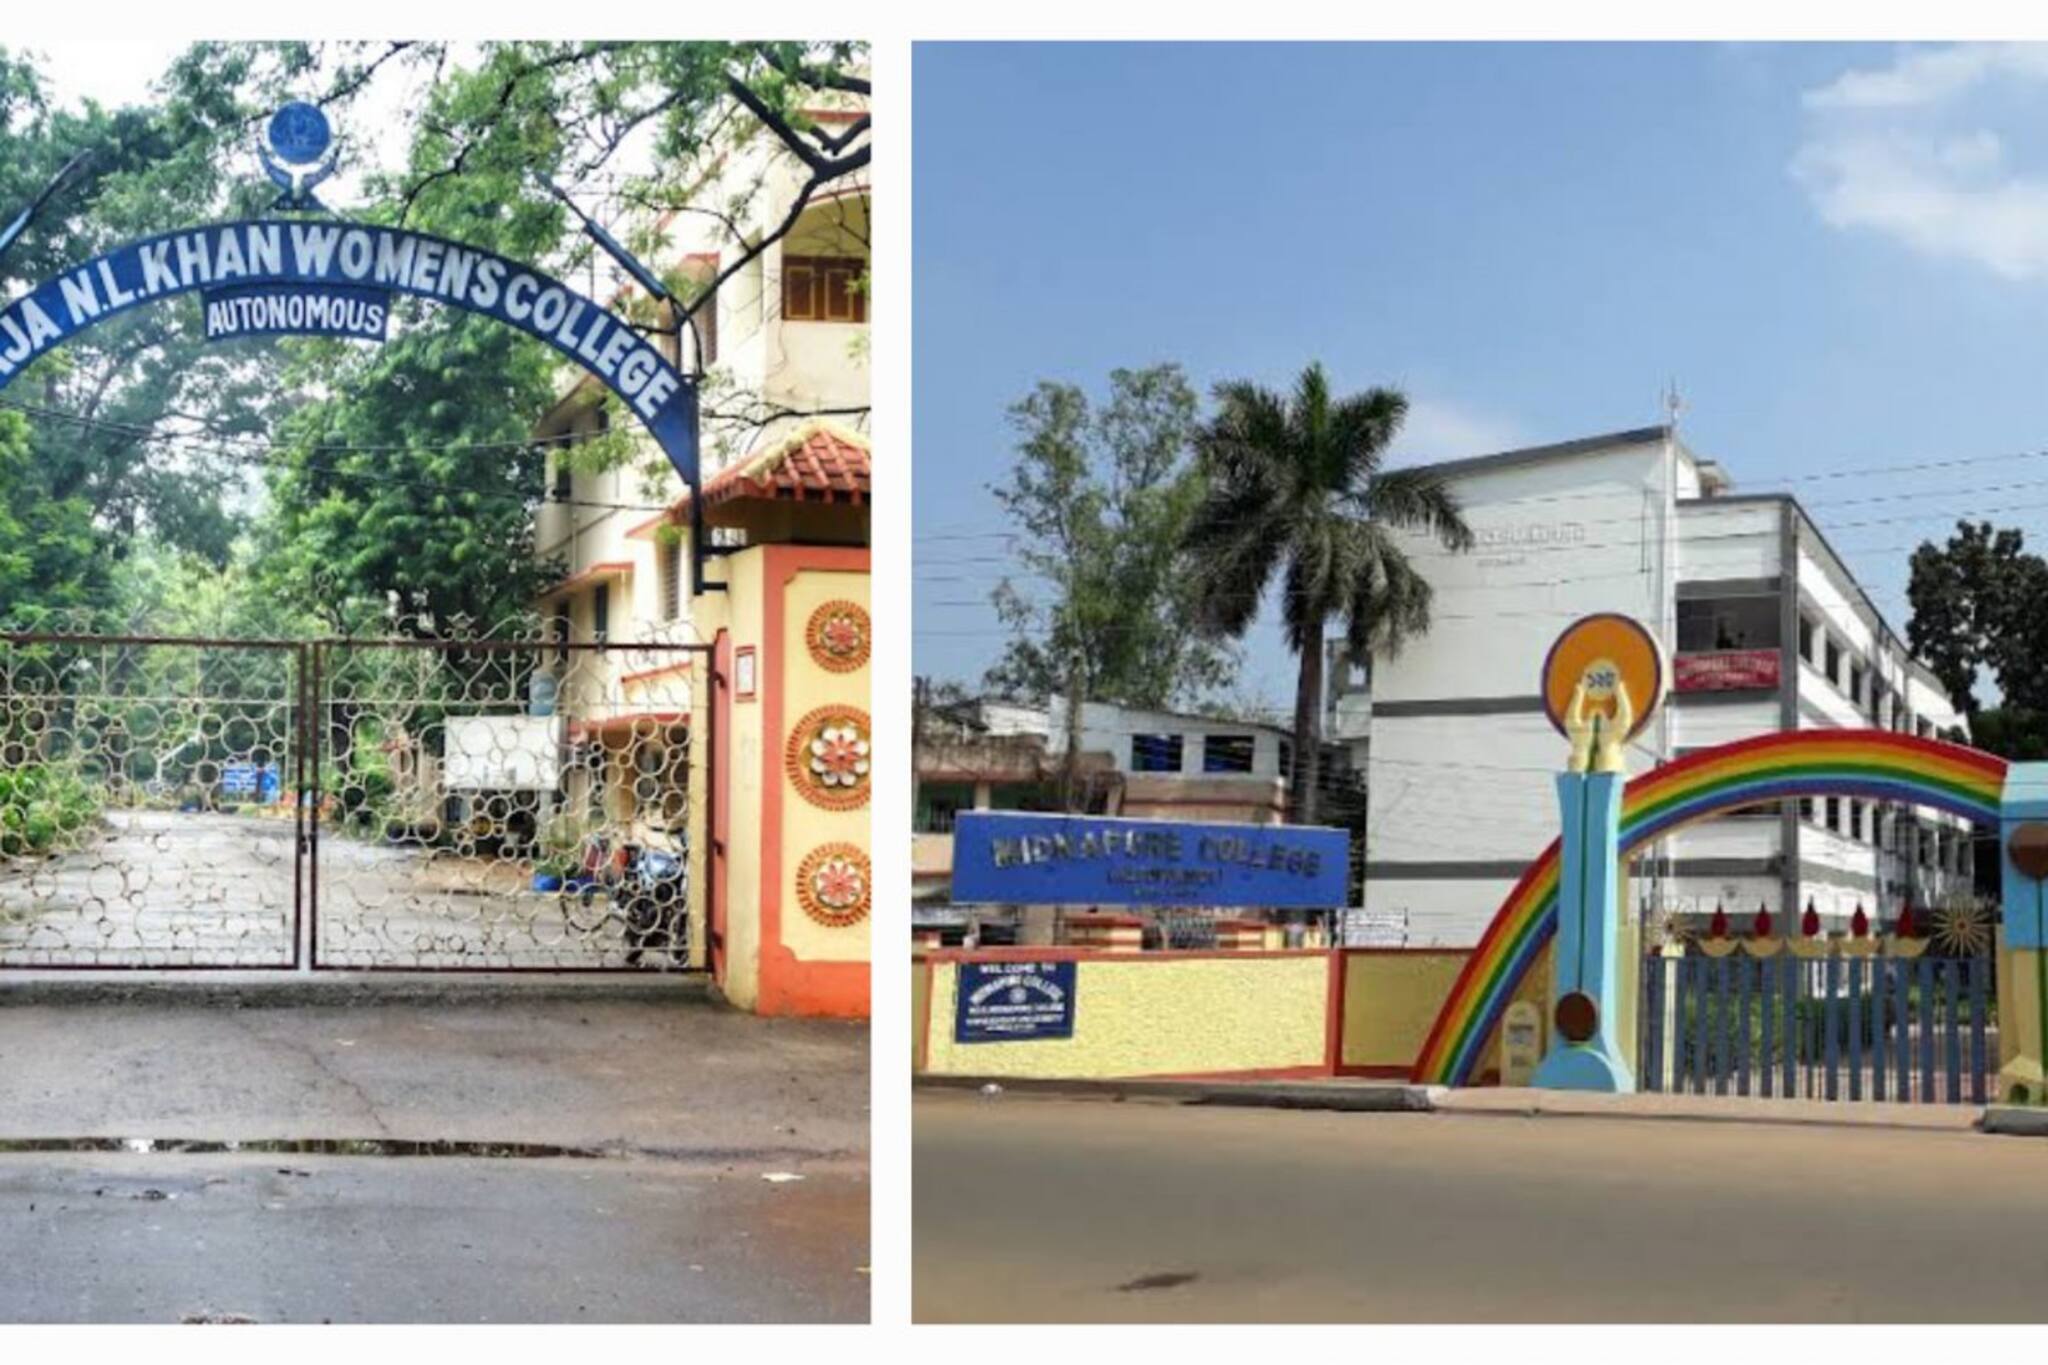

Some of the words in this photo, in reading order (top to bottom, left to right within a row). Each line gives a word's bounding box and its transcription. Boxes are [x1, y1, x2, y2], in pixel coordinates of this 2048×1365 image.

[207, 294, 385, 337] AUTONOMOUS
[289, 225, 507, 308] WOMEN'S
[504, 274, 680, 419] COLLEGE
